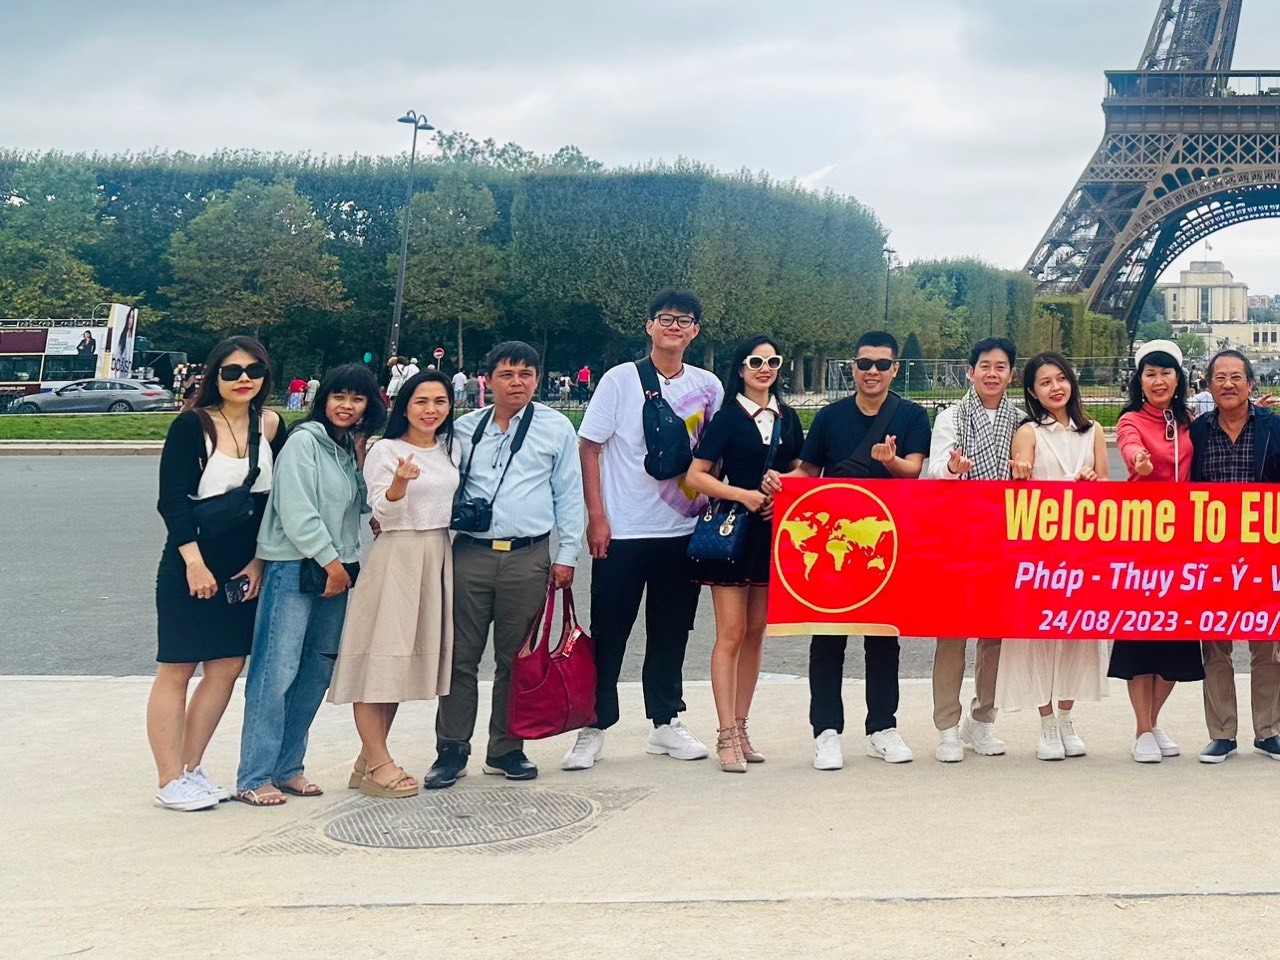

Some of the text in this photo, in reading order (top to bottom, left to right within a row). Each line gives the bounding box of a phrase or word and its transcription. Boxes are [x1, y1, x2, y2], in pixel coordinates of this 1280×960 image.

[1004, 488, 1177, 543] Welcome
[1189, 490, 1227, 544] To
[1014, 560, 1085, 598] Pháp
[1110, 561, 1175, 598] Thụy
[1179, 563, 1210, 591] Sĩ
[1230, 556, 1249, 591] Ý
[1038, 609, 1179, 635] 24/08/2023
